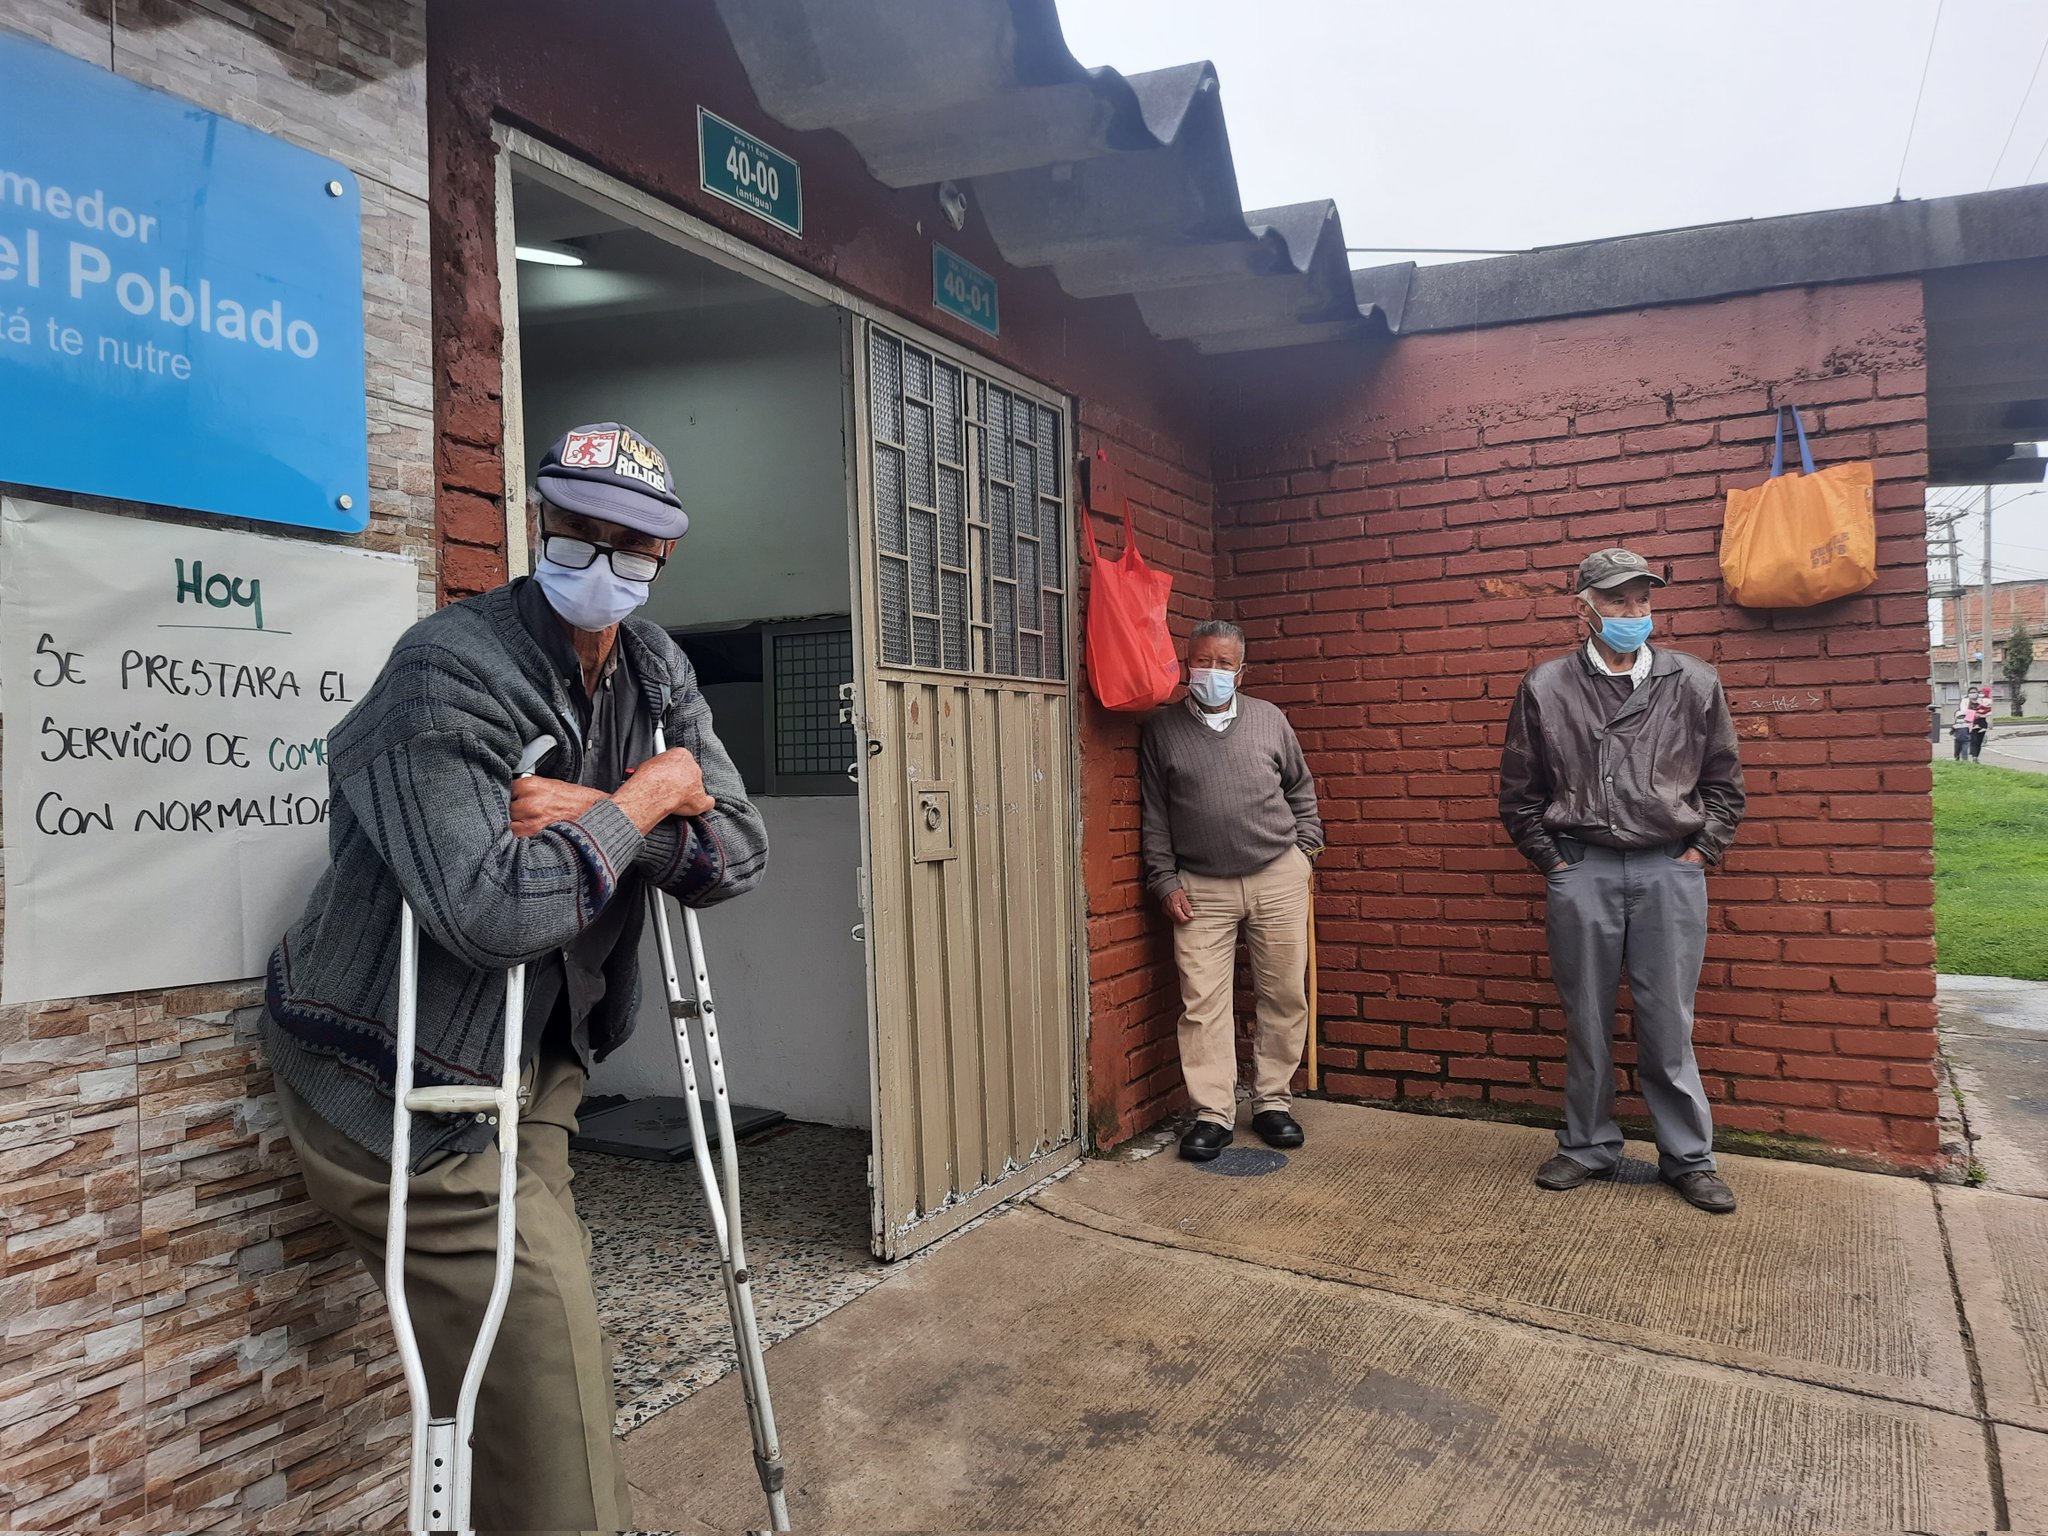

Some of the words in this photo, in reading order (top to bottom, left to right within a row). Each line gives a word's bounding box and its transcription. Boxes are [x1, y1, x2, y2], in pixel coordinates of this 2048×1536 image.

[726, 146, 779, 201] 40-00
[736, 185, 772, 213] (antigua)
[69, 242, 319, 359] Poblado
[944, 271, 990, 317] 40-01
[47, 316, 84, 356] te
[99, 335, 192, 380] nutre
[615, 455, 667, 493] ROJOS
[34, 633, 86, 687] SE
[121, 650, 300, 699] PRESTARA
[206, 732, 250, 768] DE
[36, 791, 114, 836] CON
